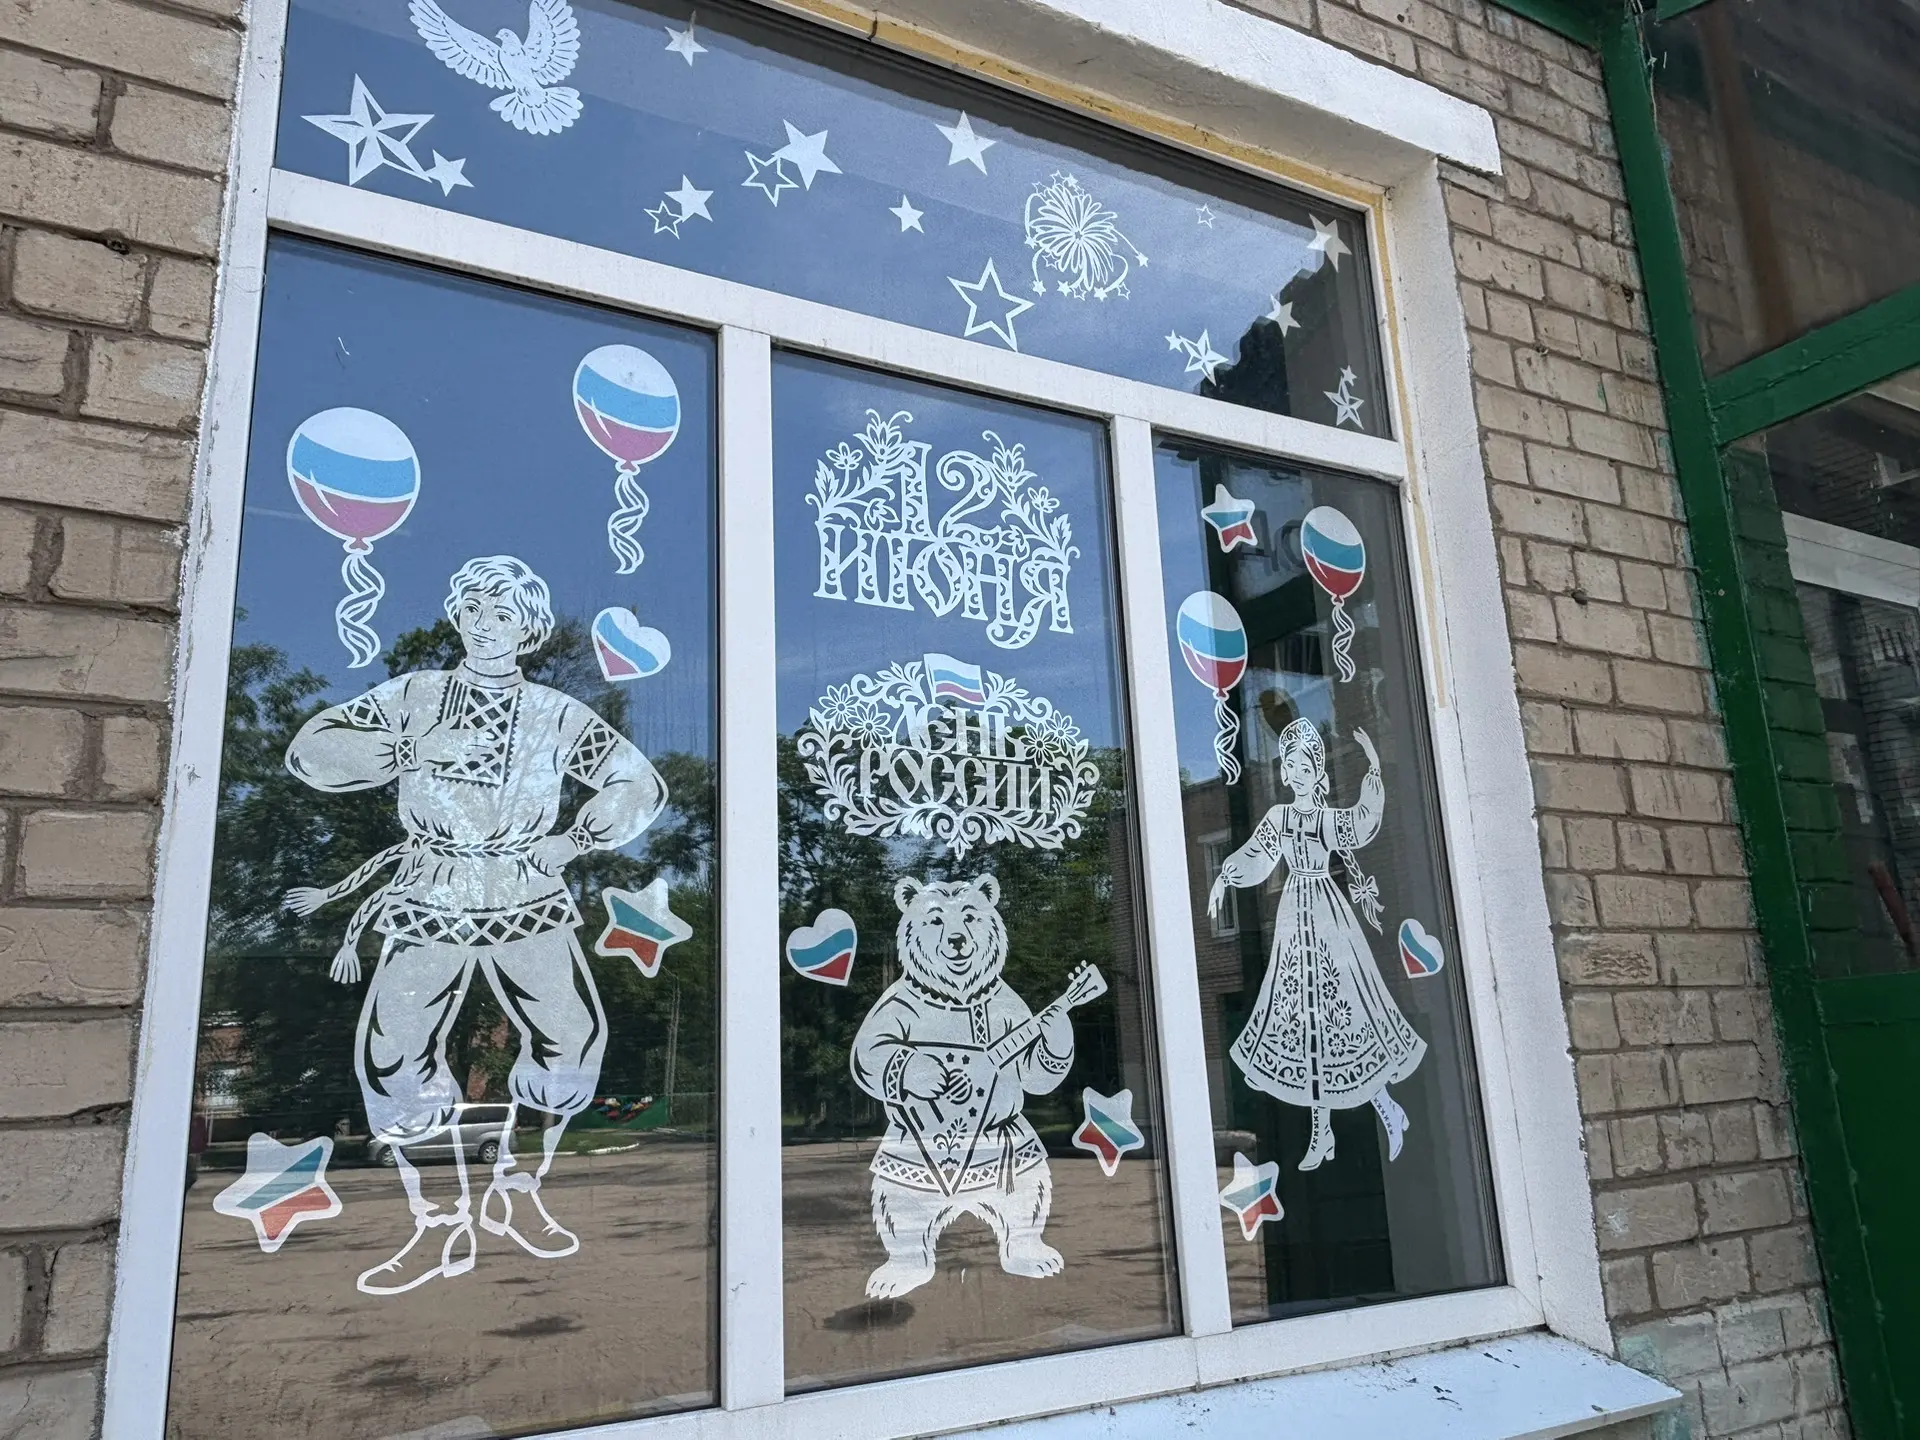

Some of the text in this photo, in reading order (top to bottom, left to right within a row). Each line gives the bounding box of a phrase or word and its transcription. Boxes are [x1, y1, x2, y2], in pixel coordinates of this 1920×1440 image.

[891, 440, 1001, 549] 12
[813, 520, 1074, 649] ИЮНЯ
[855, 745, 1054, 814] РОССИИ
